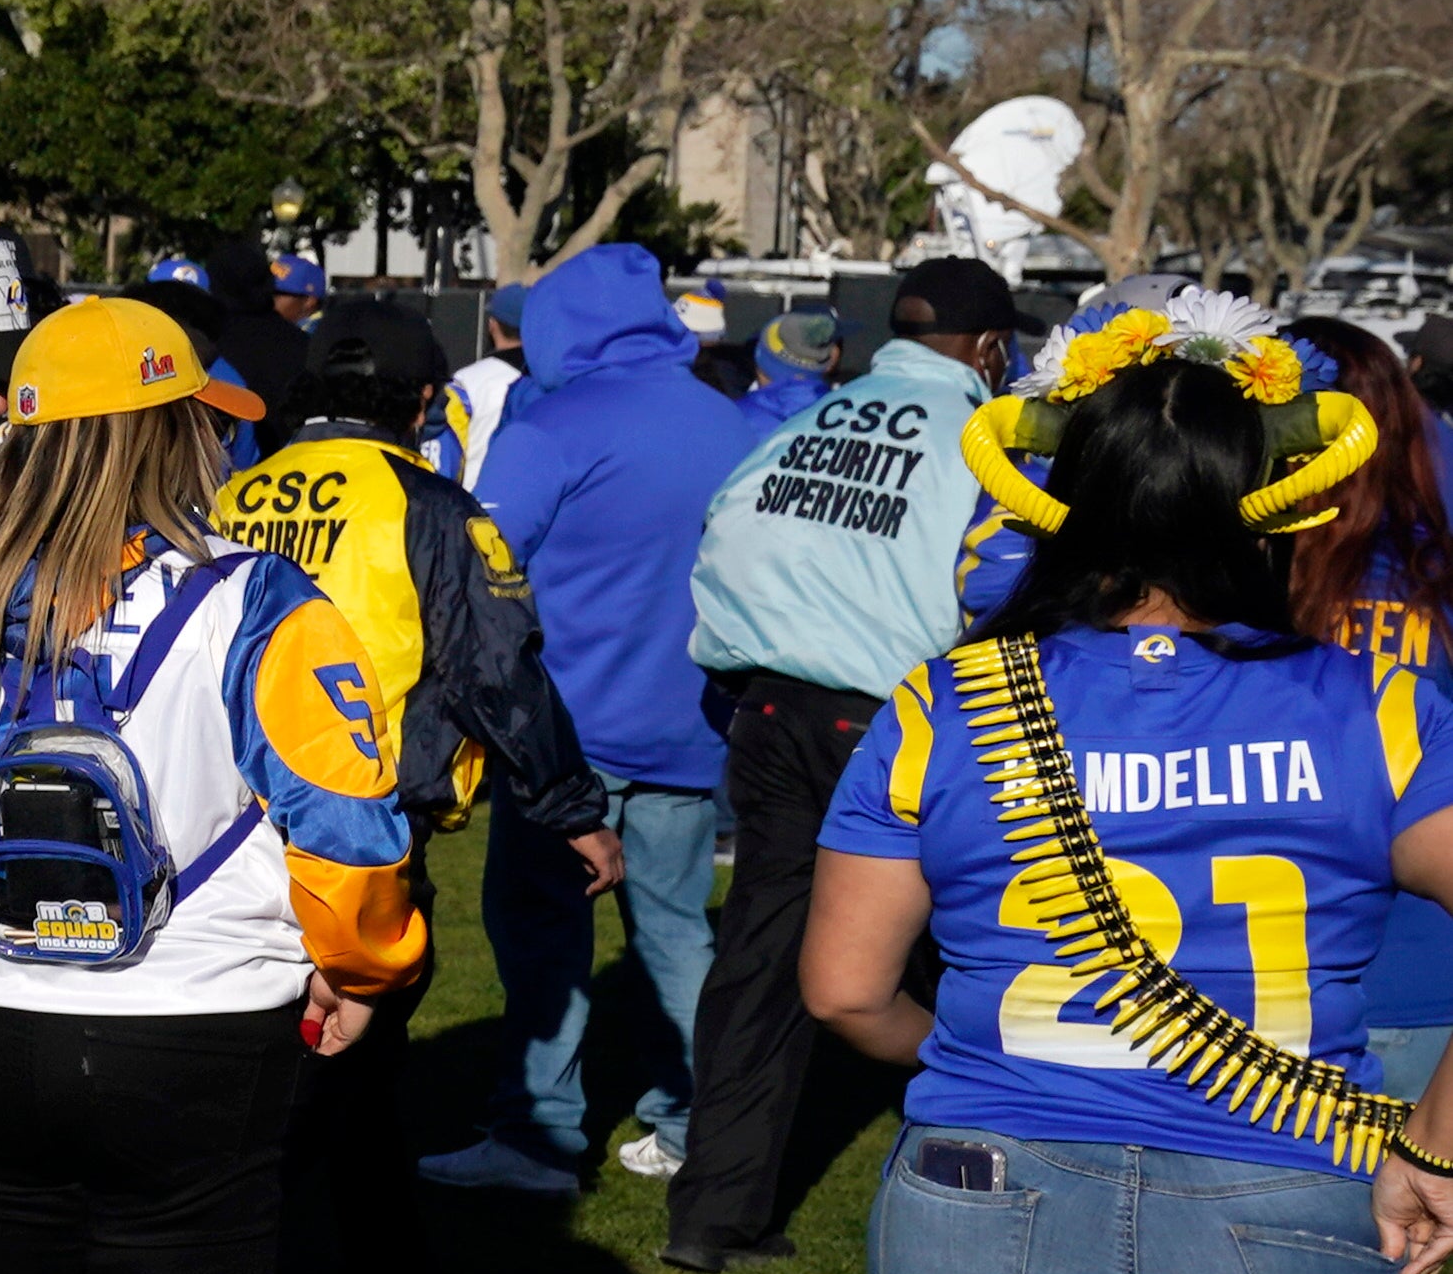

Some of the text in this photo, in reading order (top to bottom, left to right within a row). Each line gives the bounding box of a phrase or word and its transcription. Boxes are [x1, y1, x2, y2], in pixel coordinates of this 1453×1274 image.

[816, 398, 929, 441] CSC
[235, 470, 348, 514] CSC
[779, 434, 925, 492] SECURITY
[755, 473, 908, 540] SUPERVISOR
[1332, 599, 1432, 667] EEN
[1003, 739, 1323, 814] MDELITA
[36, 921, 116, 940] SQUAD
[39, 937, 119, 951] INGLEWOOD
[998, 854, 1313, 1070] 21
